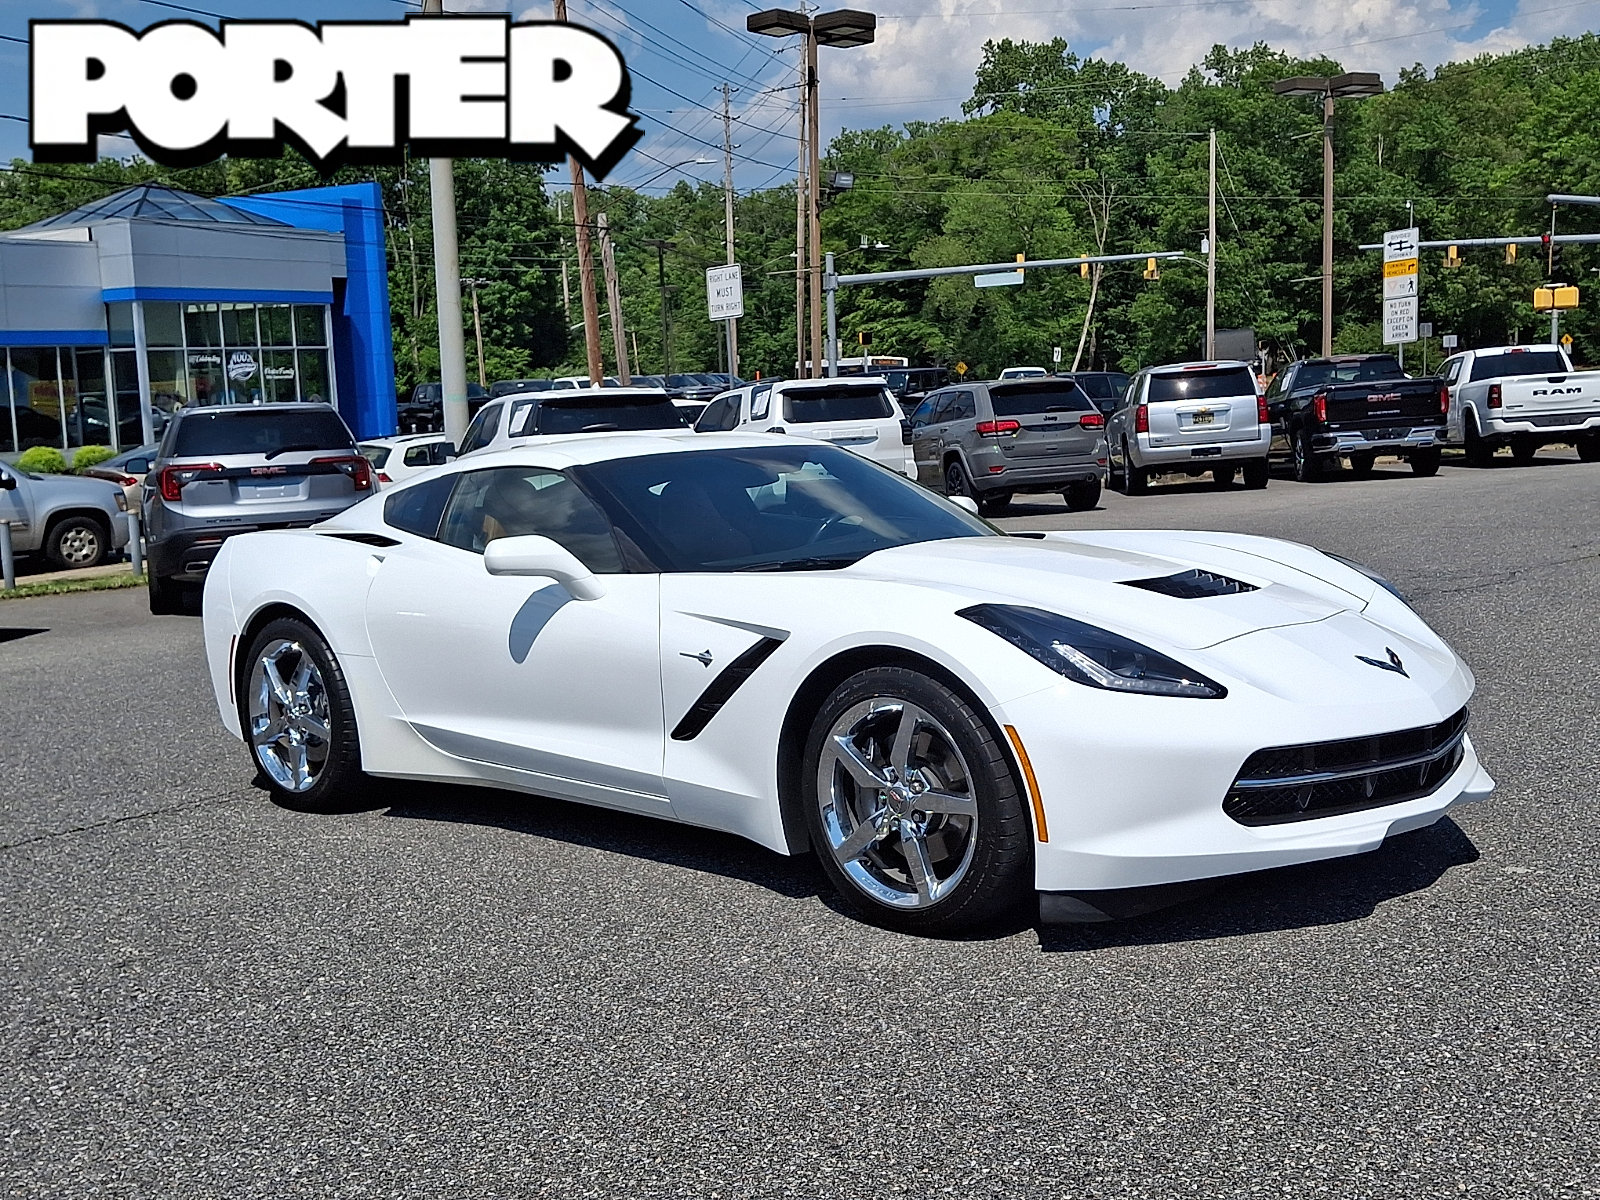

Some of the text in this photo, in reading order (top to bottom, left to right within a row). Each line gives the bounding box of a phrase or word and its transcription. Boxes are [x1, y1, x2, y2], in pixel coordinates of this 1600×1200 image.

[709, 271, 738, 283] RIGHT LANE
[716, 286, 733, 298] MUST
[711, 301, 740, 313] TURN RIGHT
[1387, 317, 1405, 325] EXCEPT
[1532, 387, 1582, 396] RAM
[1367, 393, 1401, 402] GMC
[250, 466, 287, 475] GMC
